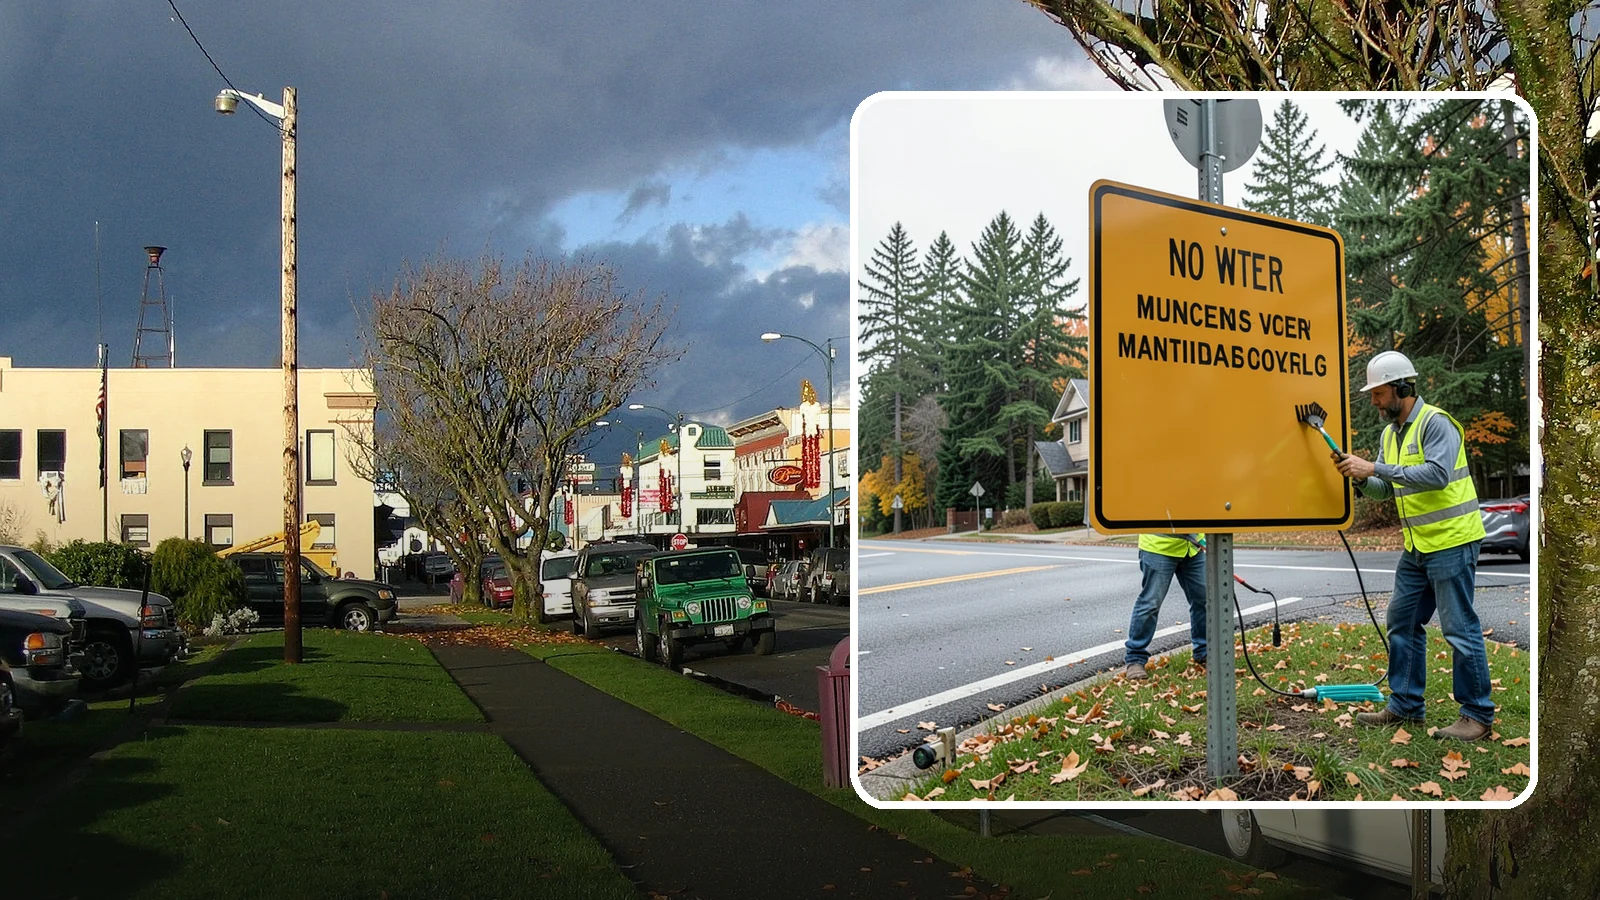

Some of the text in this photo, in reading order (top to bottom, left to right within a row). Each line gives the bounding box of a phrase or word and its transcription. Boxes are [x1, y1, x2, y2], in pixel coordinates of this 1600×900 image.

[1169, 238, 1284, 294] NO WTER
[1137, 294, 1251, 332] MUNCENS
[673, 538, 687, 546] STOP
